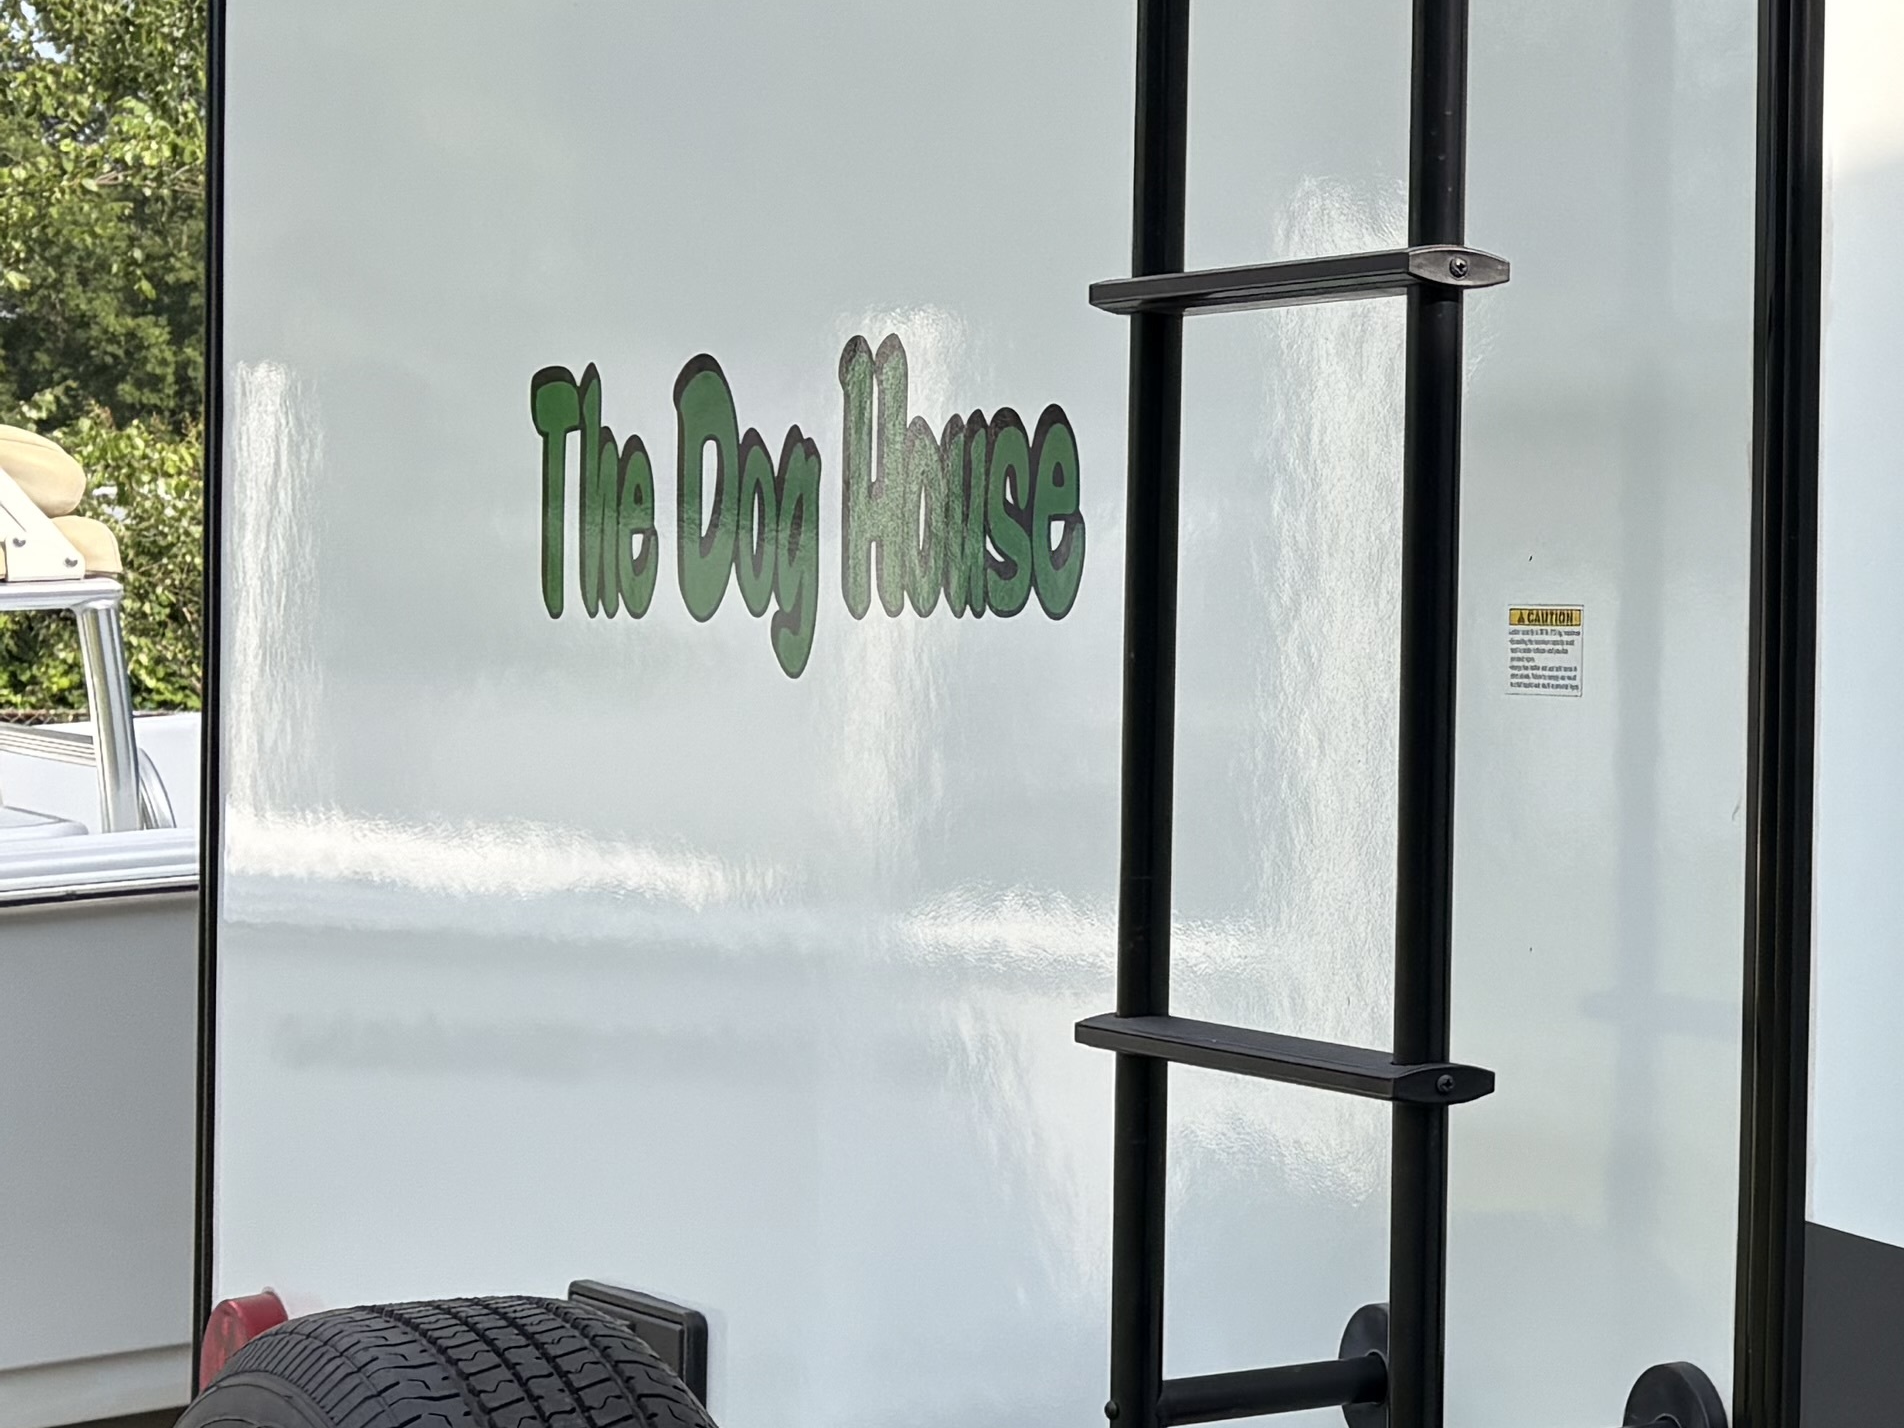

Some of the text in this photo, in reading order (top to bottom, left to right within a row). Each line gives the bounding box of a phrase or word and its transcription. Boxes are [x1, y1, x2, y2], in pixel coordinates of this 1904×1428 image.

[530, 333, 1086, 679] The Dog House
[1526, 610, 1574, 624] CAUTION
